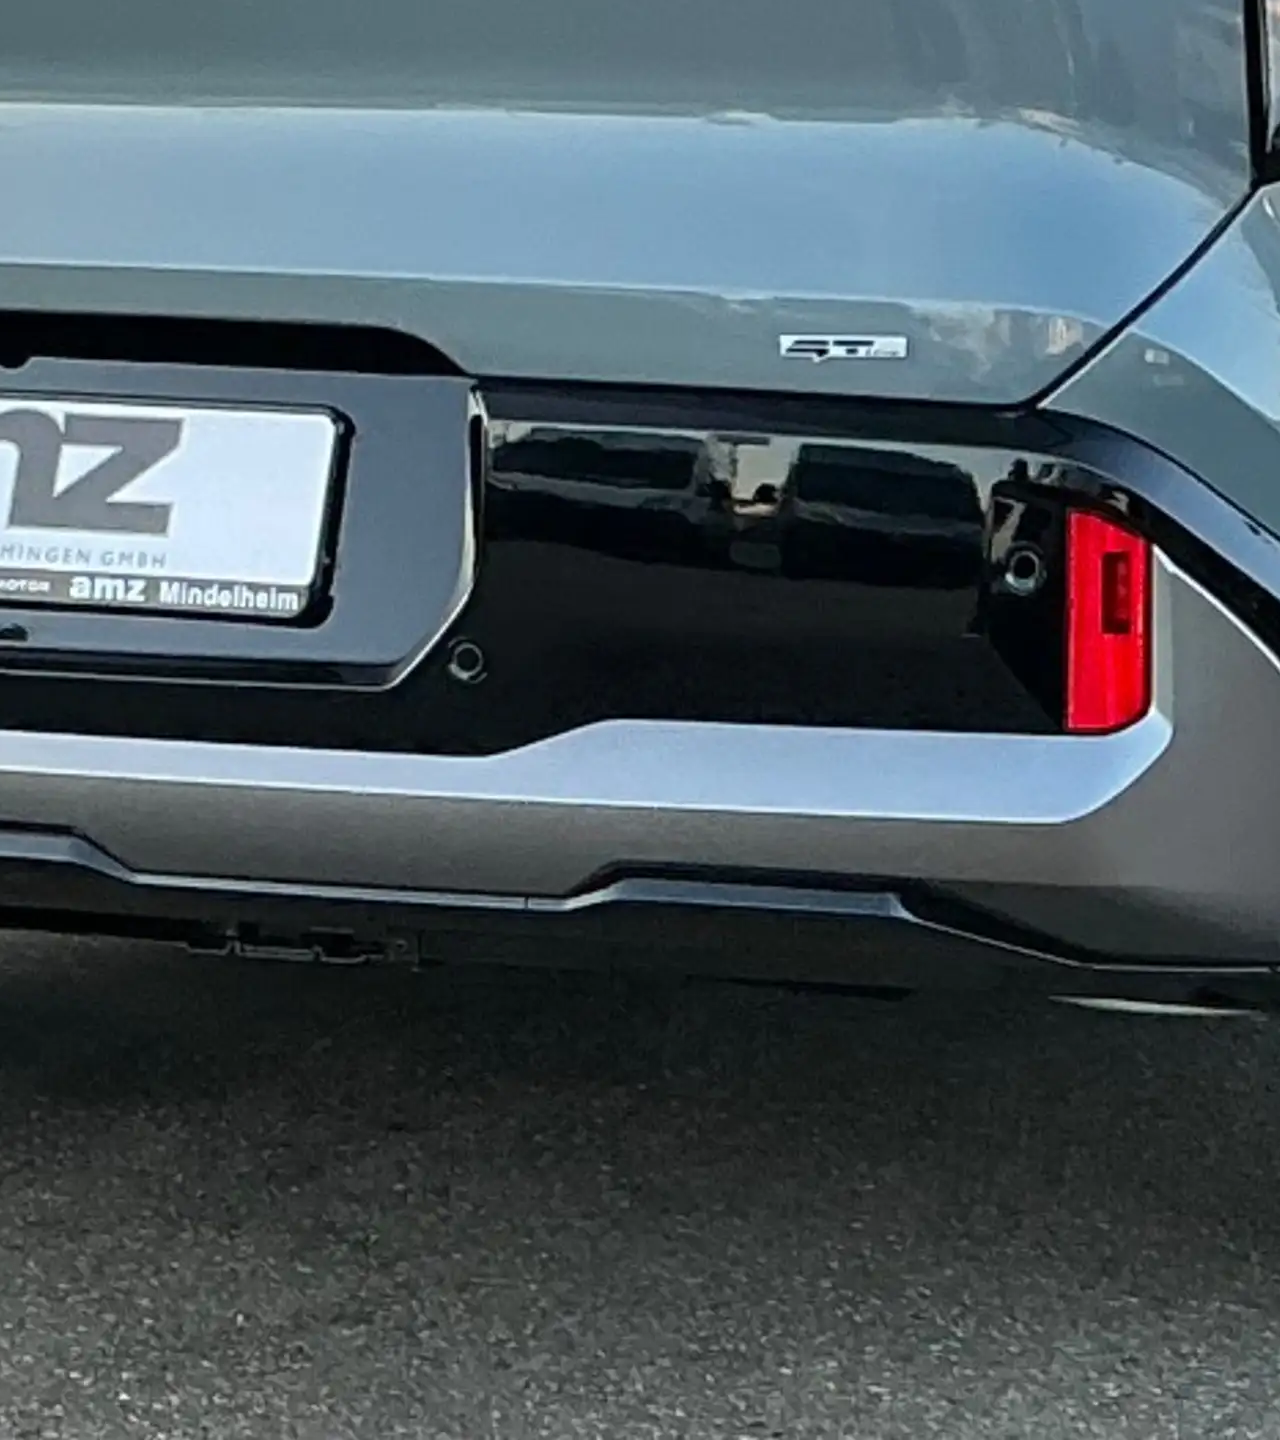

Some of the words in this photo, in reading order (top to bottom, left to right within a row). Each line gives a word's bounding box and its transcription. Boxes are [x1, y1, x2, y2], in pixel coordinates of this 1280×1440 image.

[100, 550, 166, 569] GMBH
[69, 575, 146, 603] amz
[158, 580, 299, 611] Mindelheim
